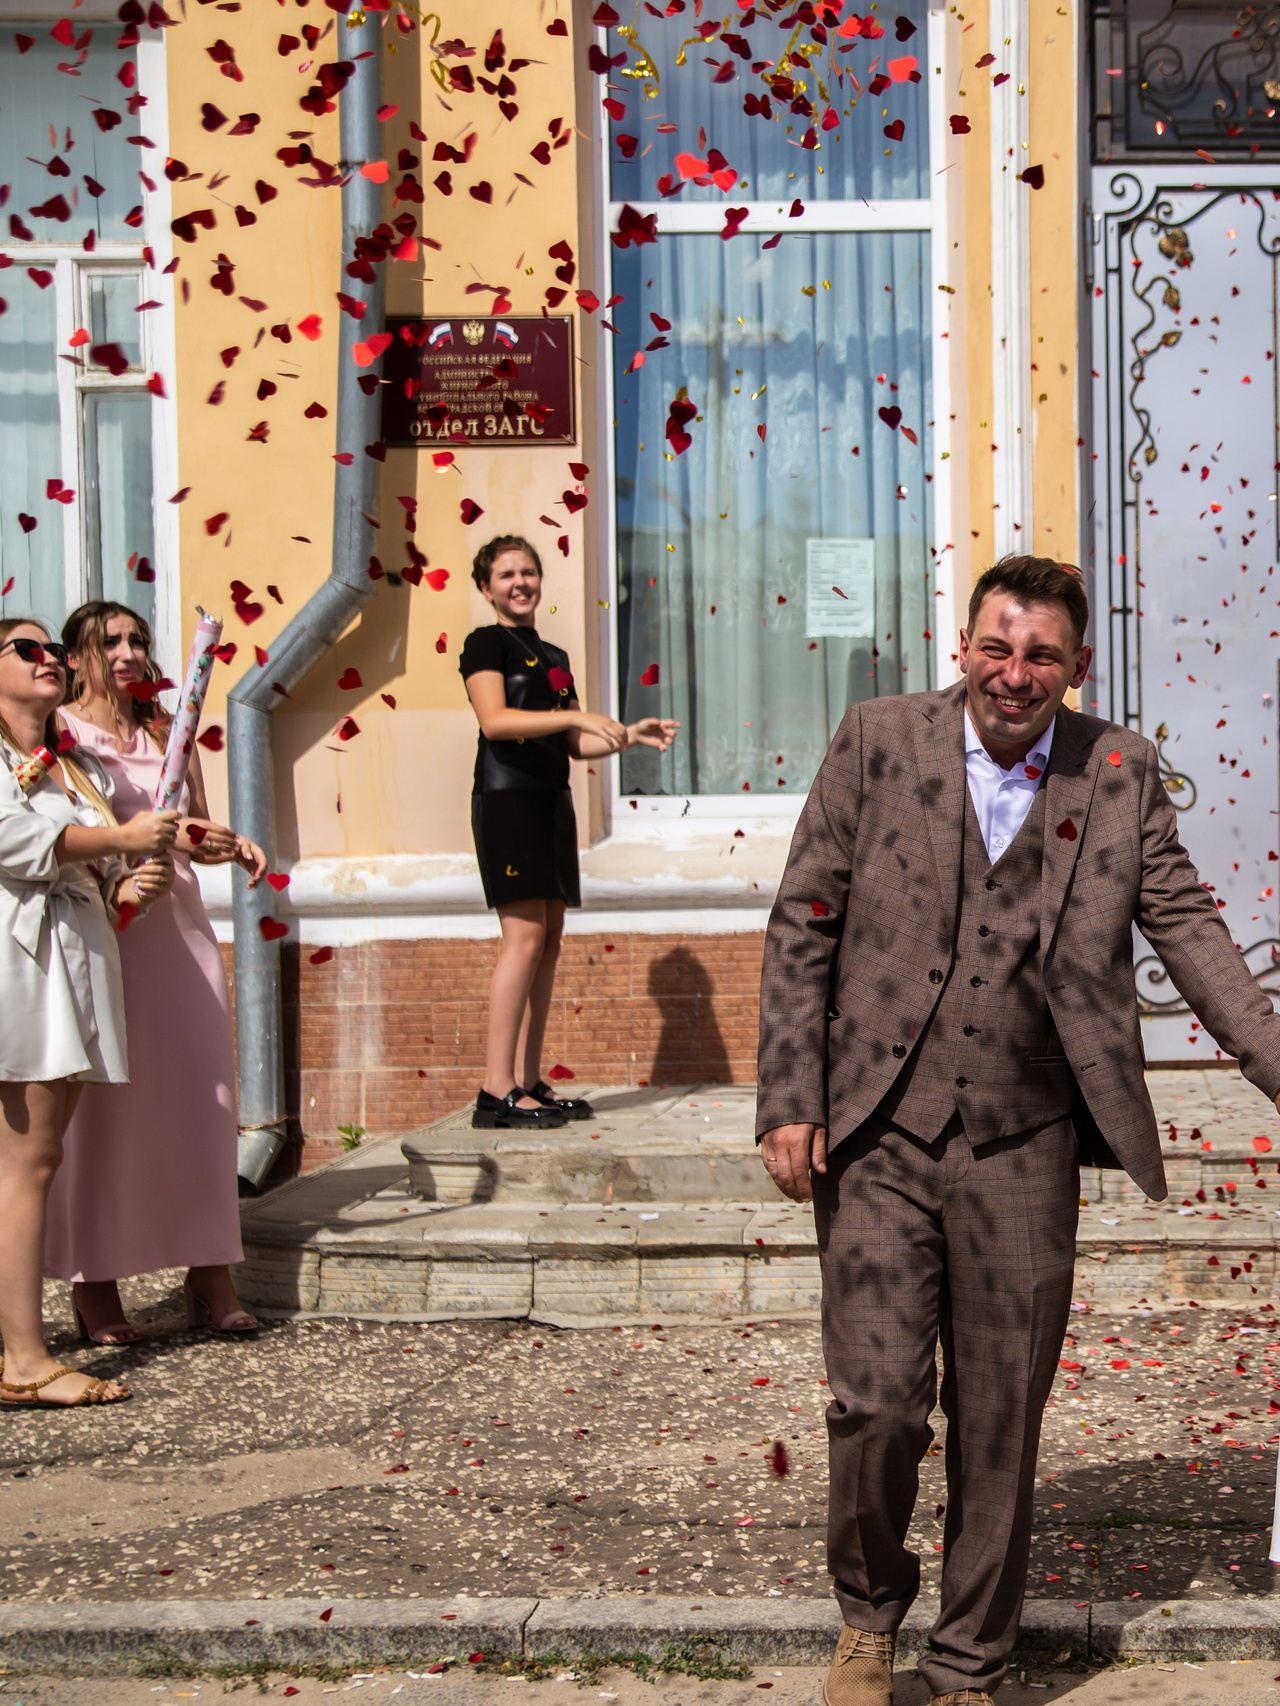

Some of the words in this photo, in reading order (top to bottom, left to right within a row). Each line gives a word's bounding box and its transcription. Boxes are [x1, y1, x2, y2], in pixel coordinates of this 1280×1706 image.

[434, 368, 514, 380] АДМИНИСТР
[410, 418, 479, 441] отдел
[484, 414, 545, 436] ЗАГС
